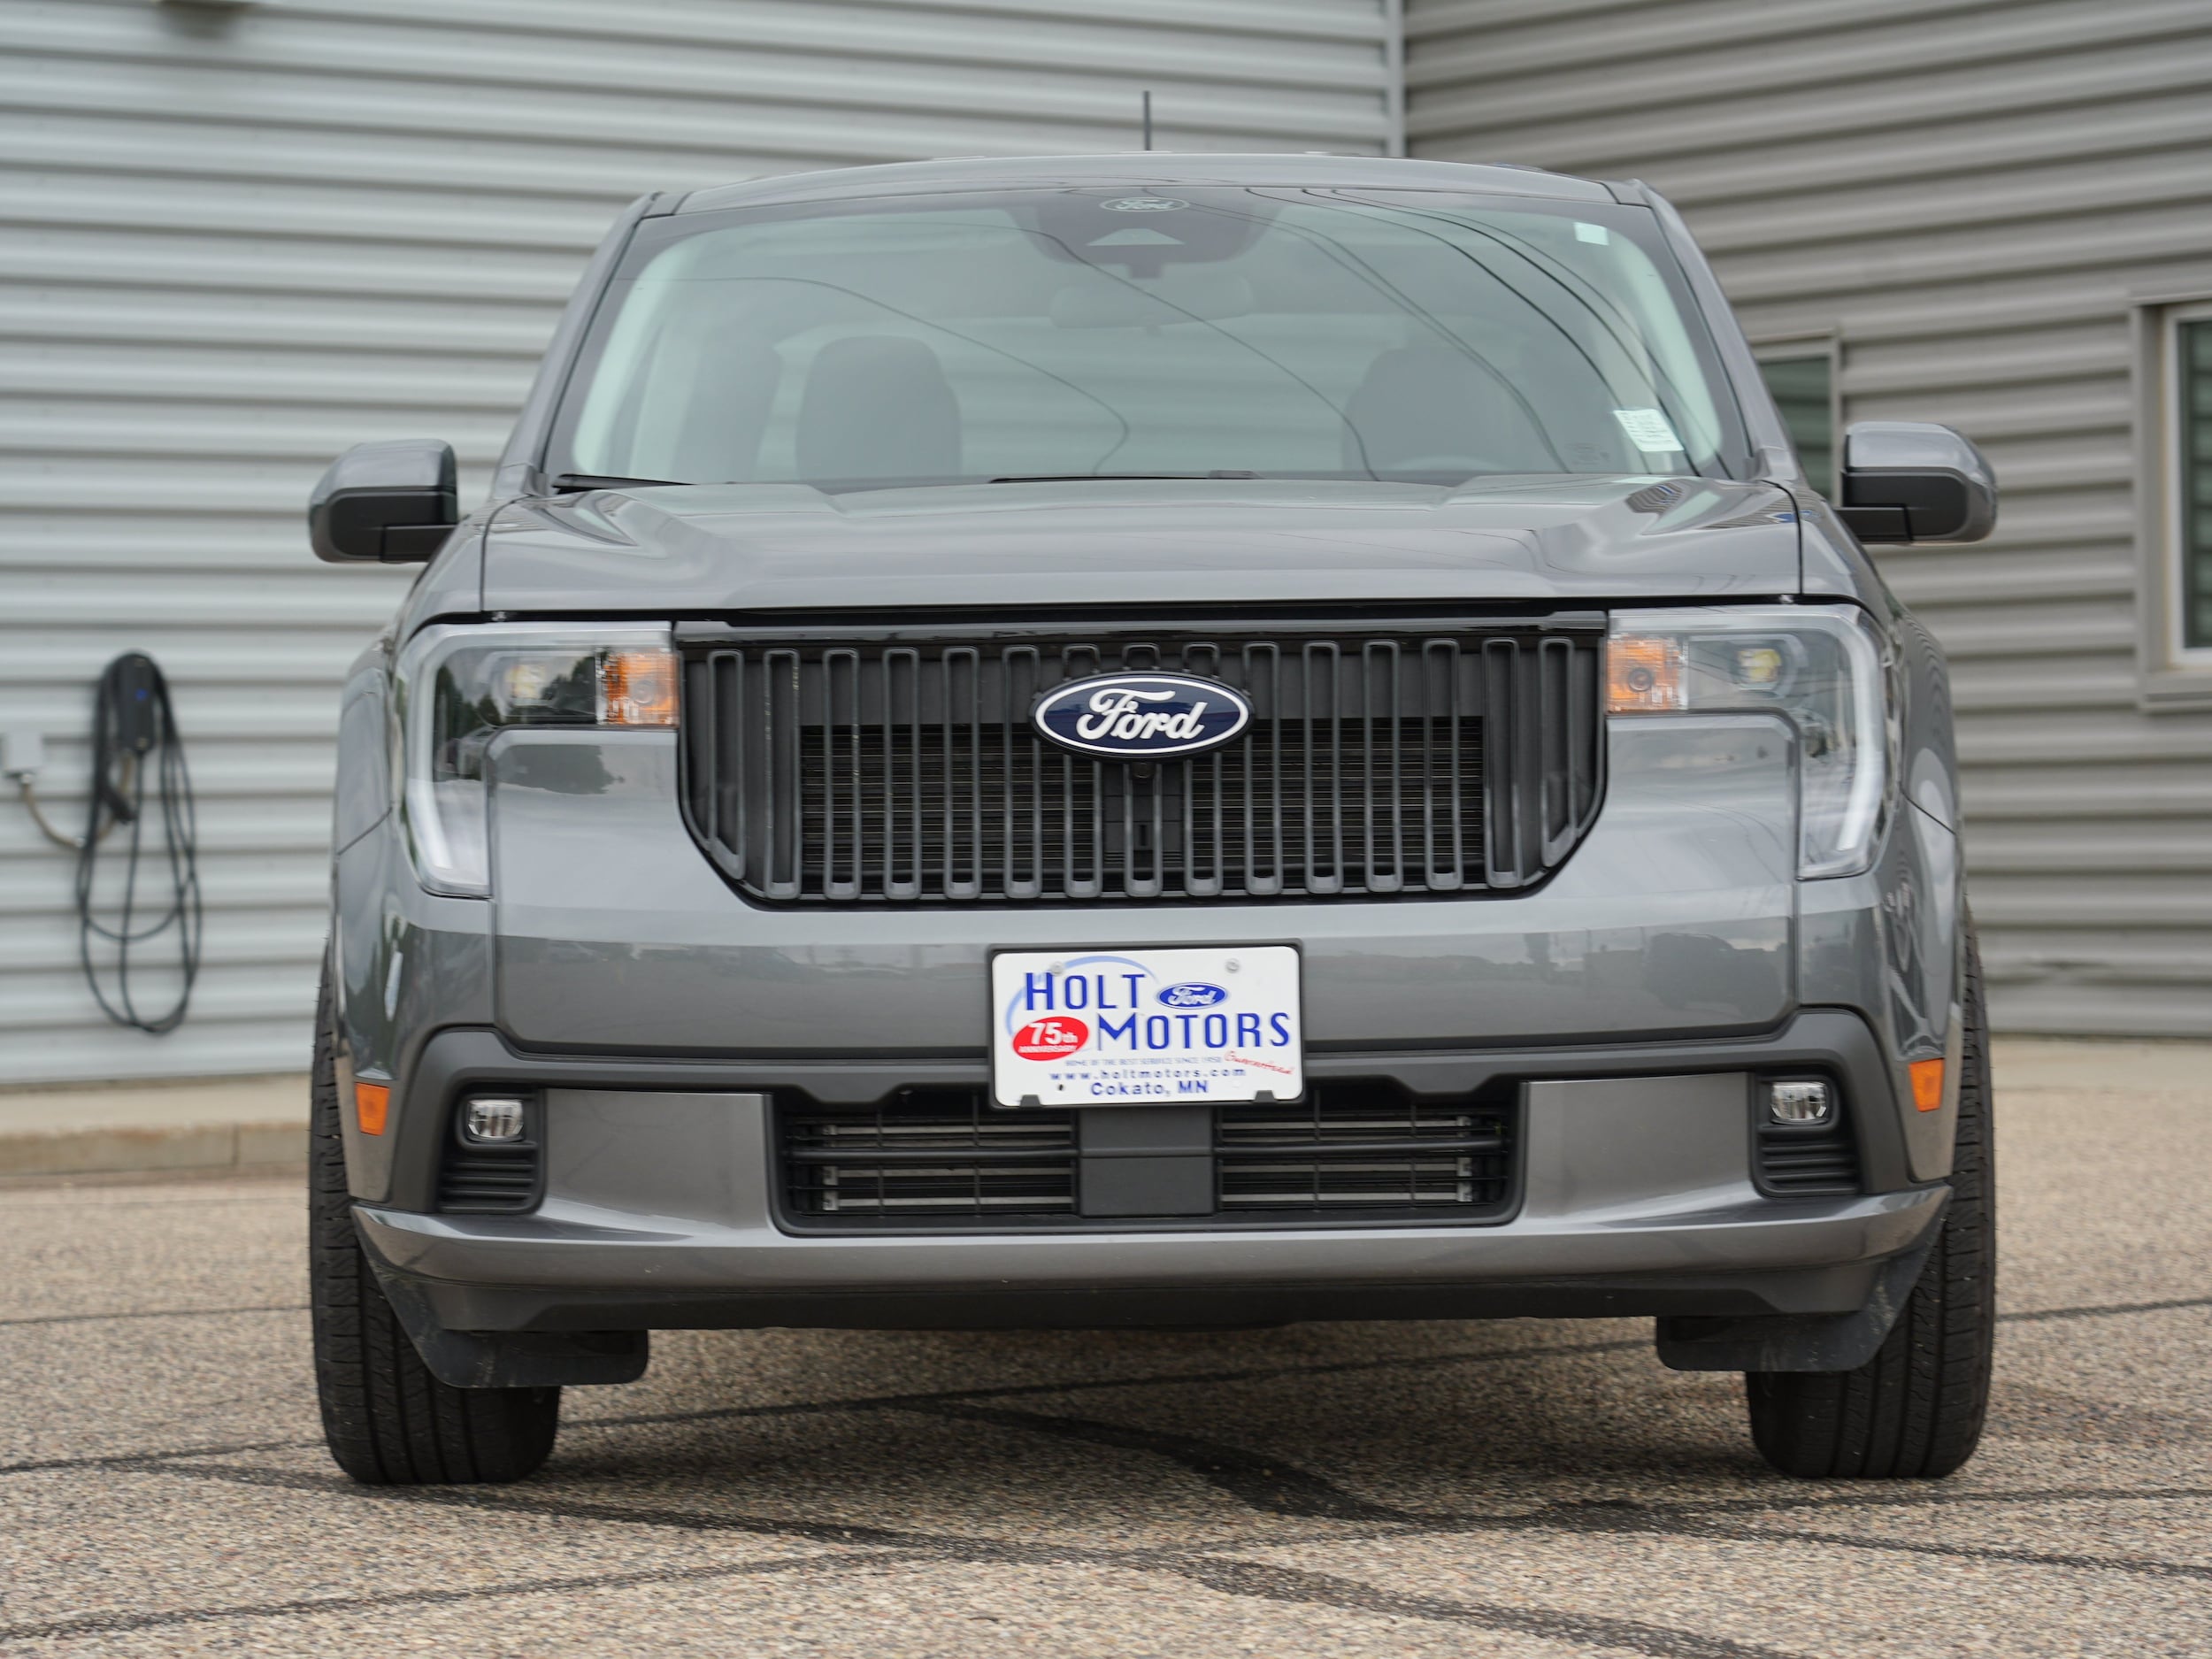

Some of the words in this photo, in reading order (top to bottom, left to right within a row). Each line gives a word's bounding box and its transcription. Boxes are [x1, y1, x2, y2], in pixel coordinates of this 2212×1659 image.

[1116, 199, 1175, 211] Ford
[1076, 687, 1209, 741] Ford
[1025, 972, 1145, 1010] HOLT
[1167, 986, 1217, 1005] Ford
[1029, 1022, 1079, 1045] 75th
[1098, 1012, 1290, 1050] MOTORS
[1049, 1068, 1247, 1080] www.holtmotors.com
[1090, 1081, 1171, 1097] Cokato,
[1178, 1079, 1209, 1094] MN
